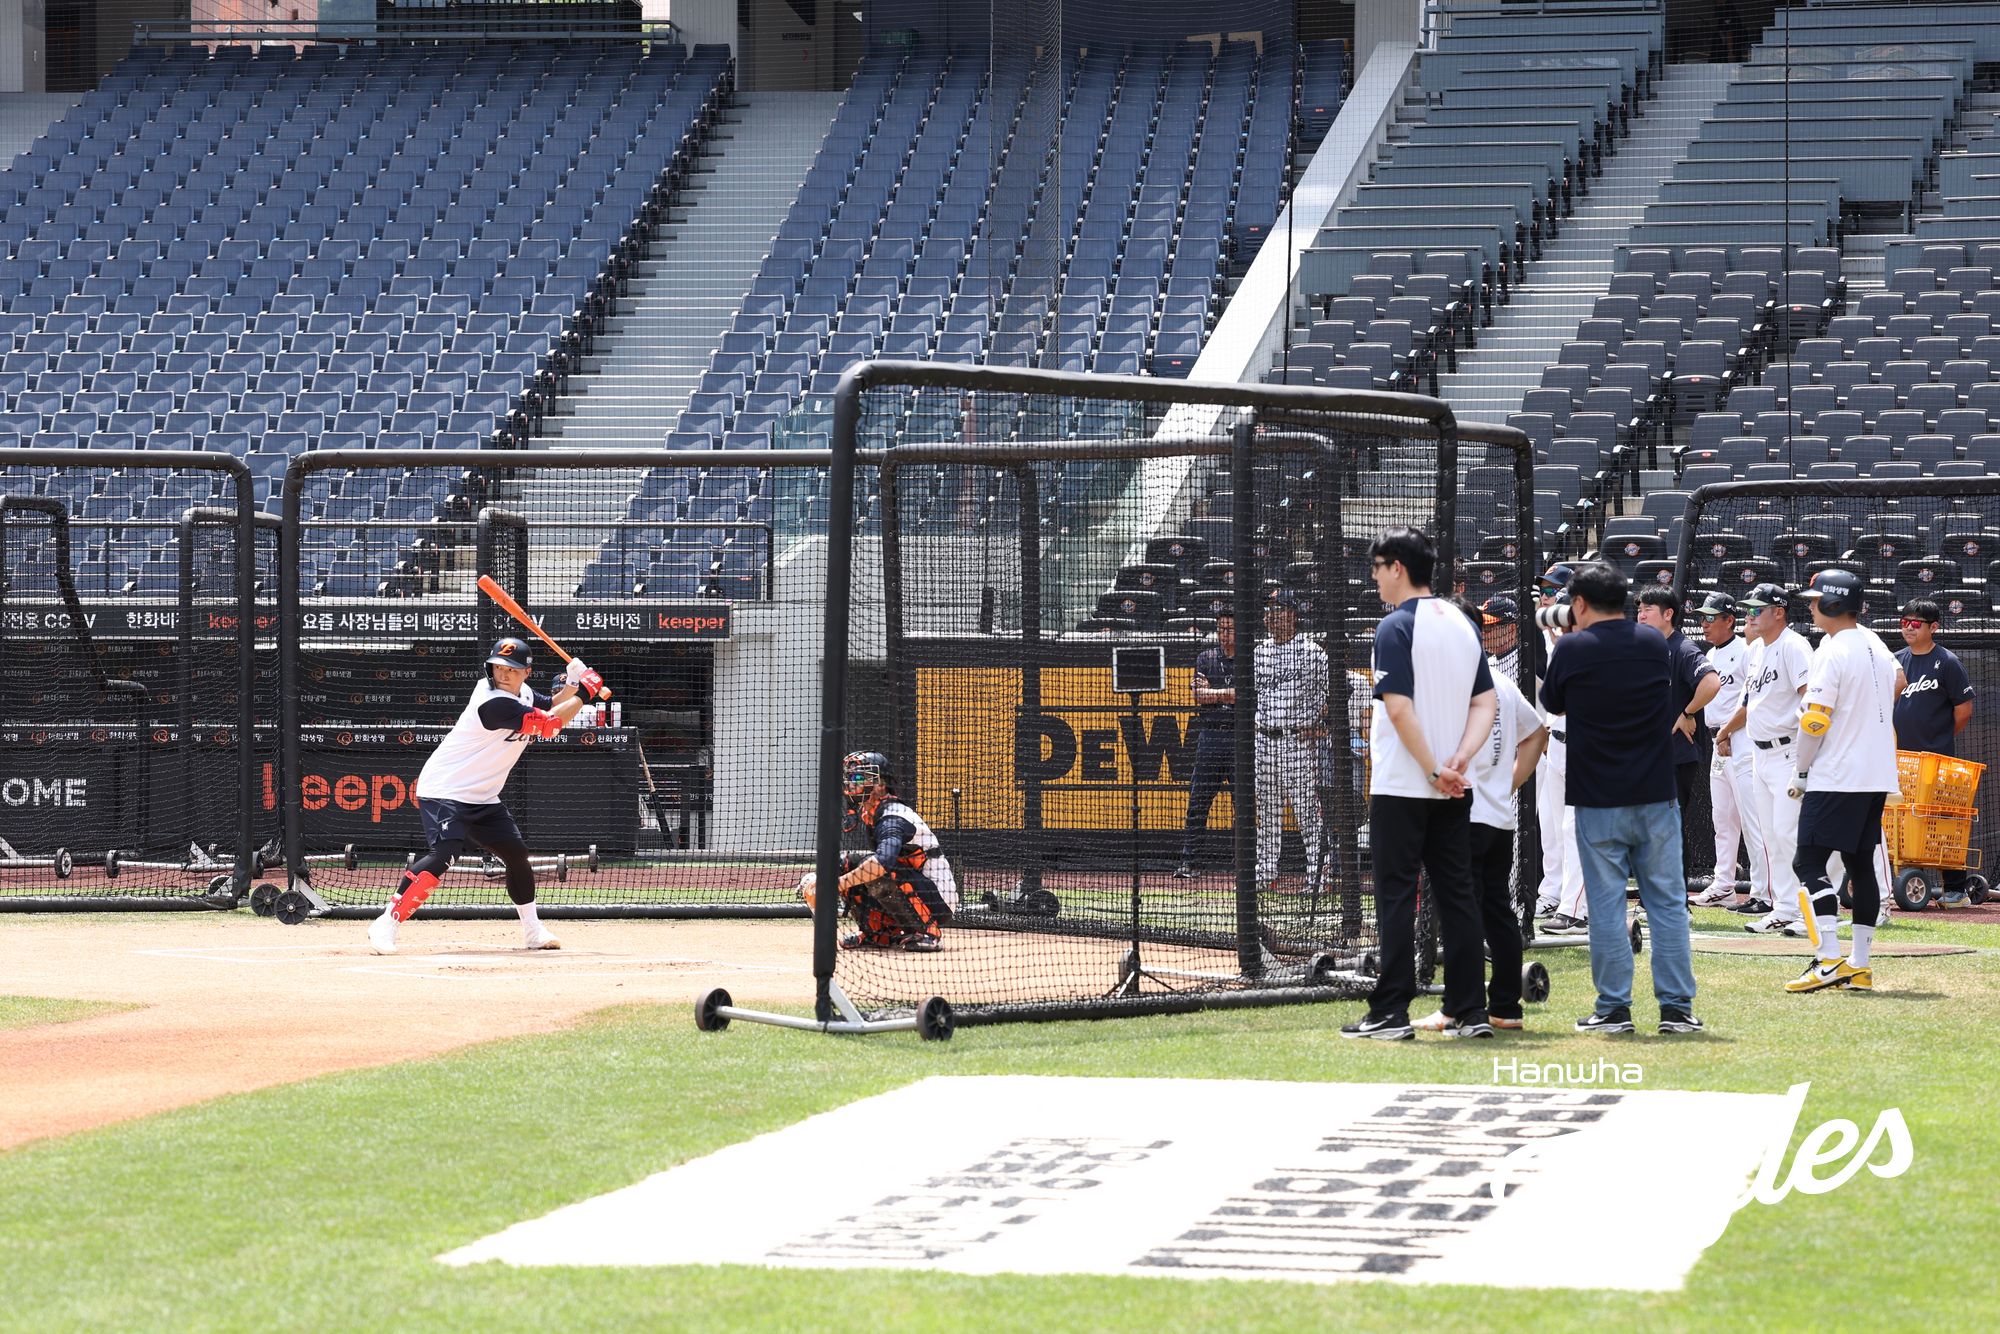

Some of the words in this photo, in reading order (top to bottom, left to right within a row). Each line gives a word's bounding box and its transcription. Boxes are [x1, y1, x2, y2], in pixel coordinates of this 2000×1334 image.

[1822, 584, 1849, 596] 한화생명
[44, 613, 96, 629] CCV
[302, 613, 334, 631] 요즘
[339, 612, 418, 631] 사장님들의
[576, 613, 641, 630] 한화비전
[658, 613, 725, 633] keeper
[354, 734, 386, 743] 한화생명
[597, 734, 628, 743] 한화생명
